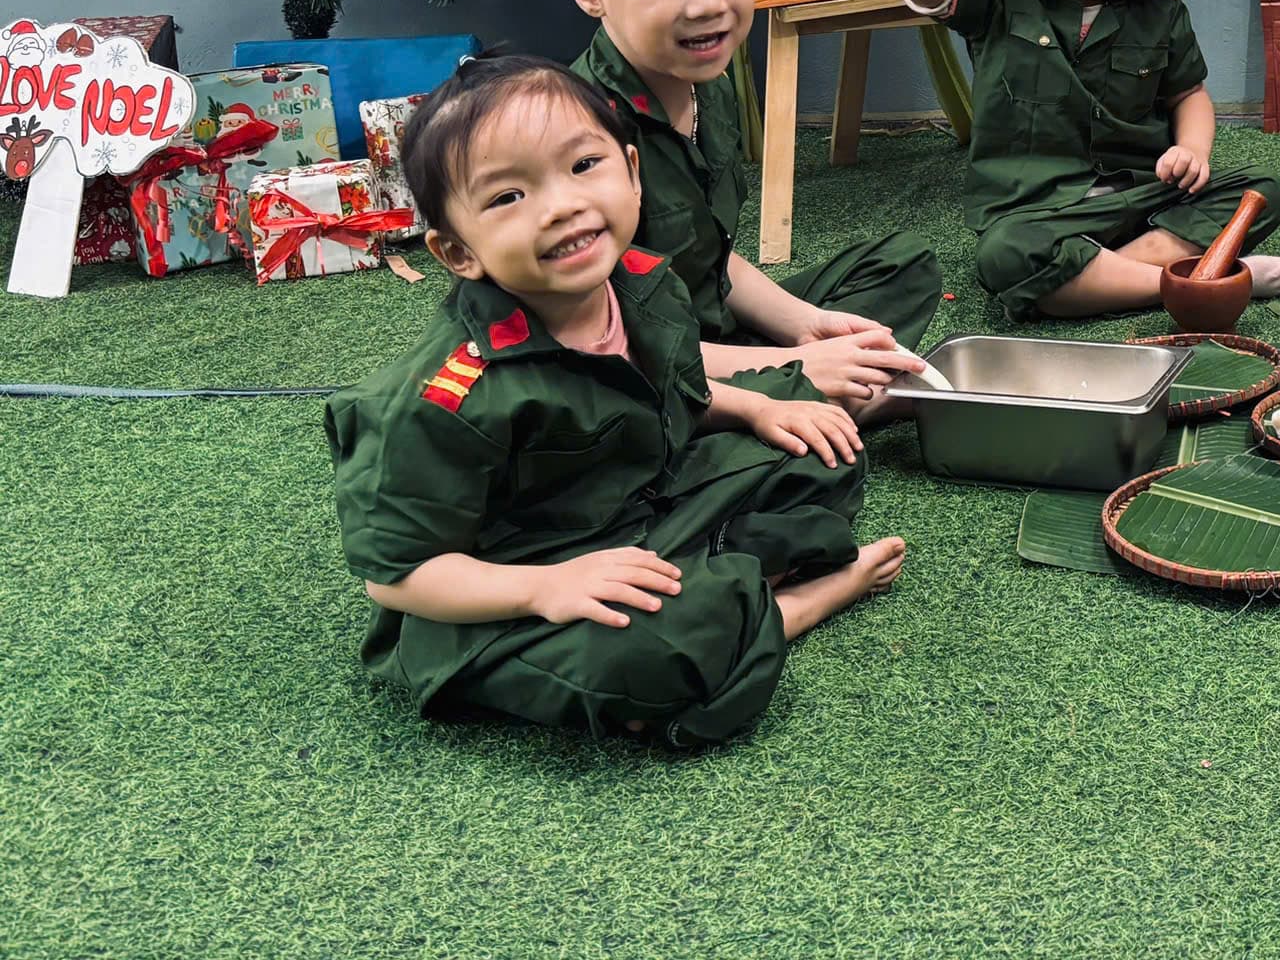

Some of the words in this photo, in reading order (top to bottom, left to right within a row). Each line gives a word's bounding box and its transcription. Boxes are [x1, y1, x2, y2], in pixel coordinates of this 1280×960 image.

[0, 56, 82, 116] LOVE
[81, 76, 180, 147] NOEL
[258, 97, 333, 116] CHRISTMA
